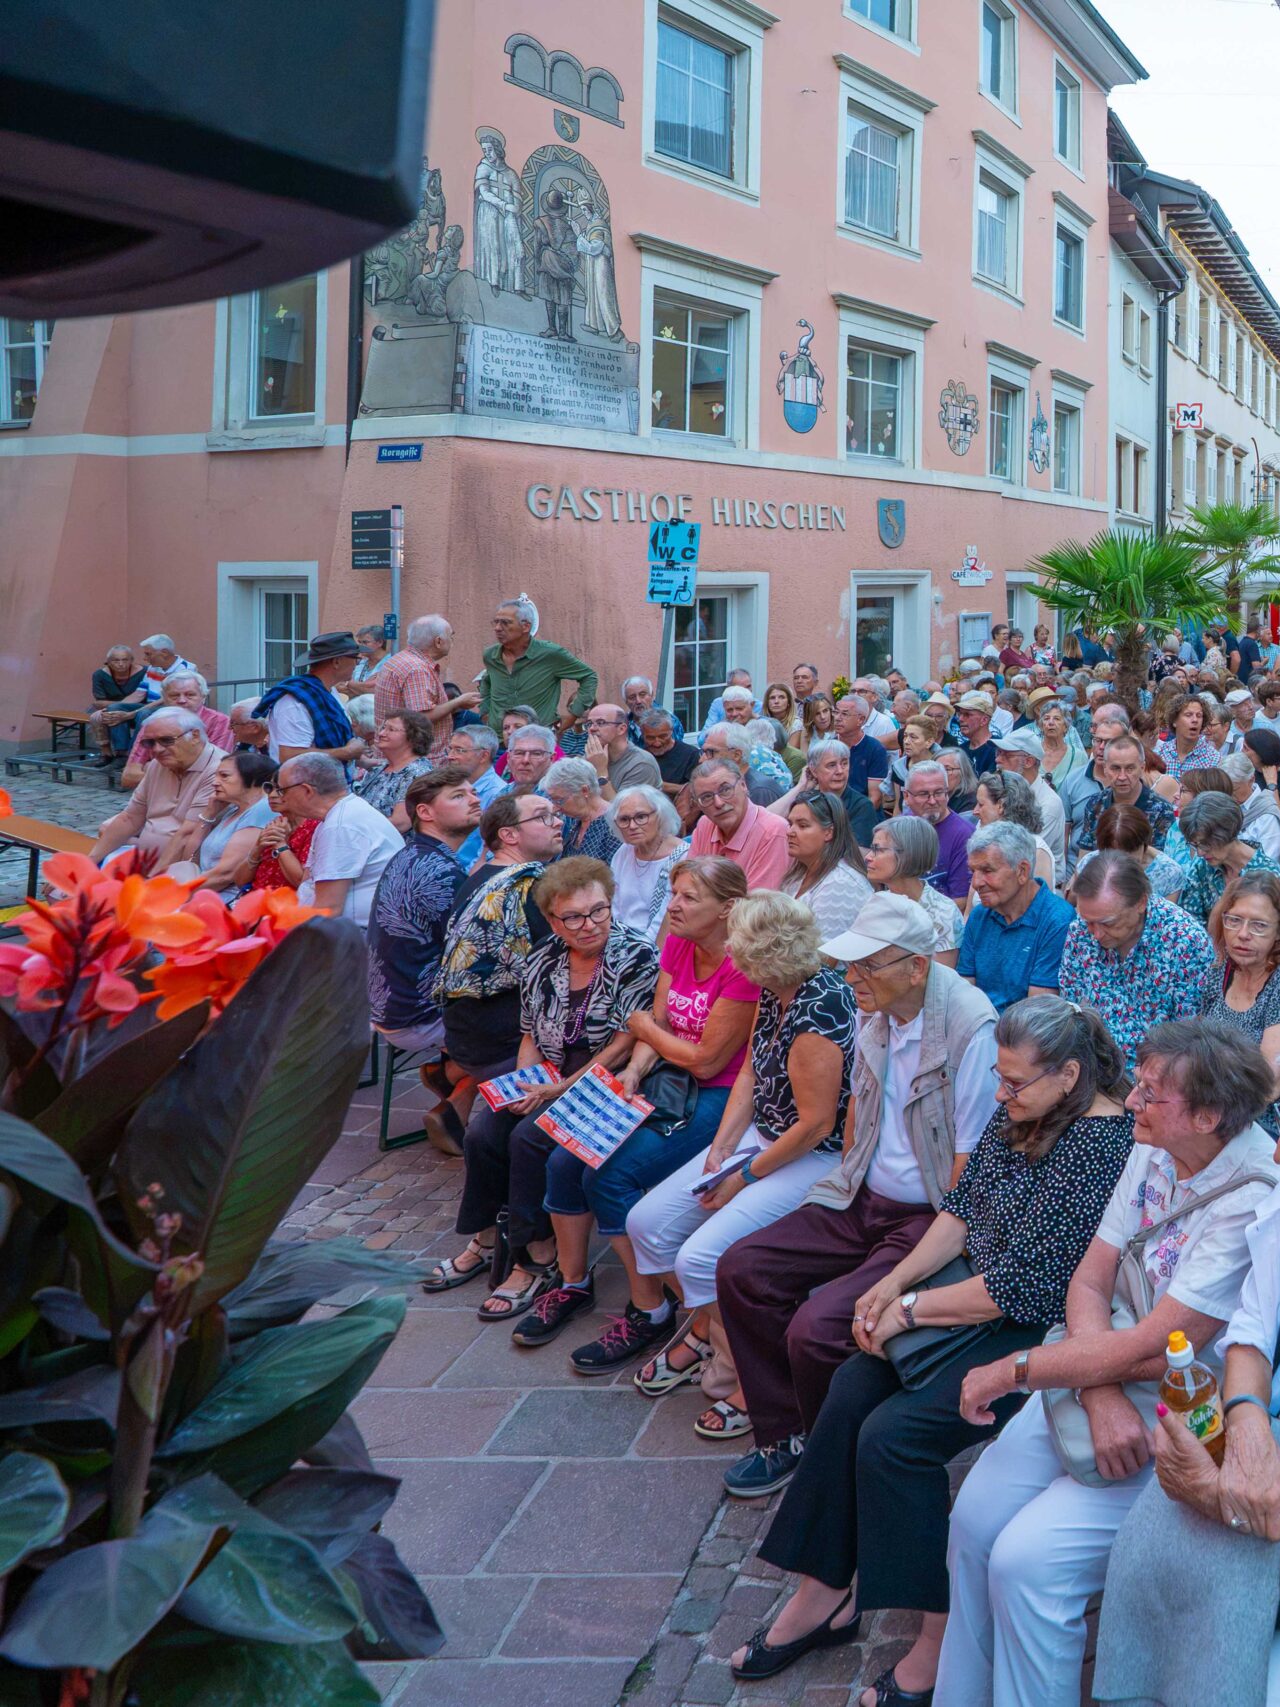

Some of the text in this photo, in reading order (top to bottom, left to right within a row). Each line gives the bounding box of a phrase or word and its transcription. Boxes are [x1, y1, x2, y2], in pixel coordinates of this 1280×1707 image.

[482, 339, 526, 357] Herberge
[573, 356, 615, 371] Bernhard
[482, 352, 534, 369] Clairvaux
[482, 364, 495, 375] Er
[1183, 410, 1196, 421] M
[526, 484, 847, 531] GASTHOF HIRSCHEN
